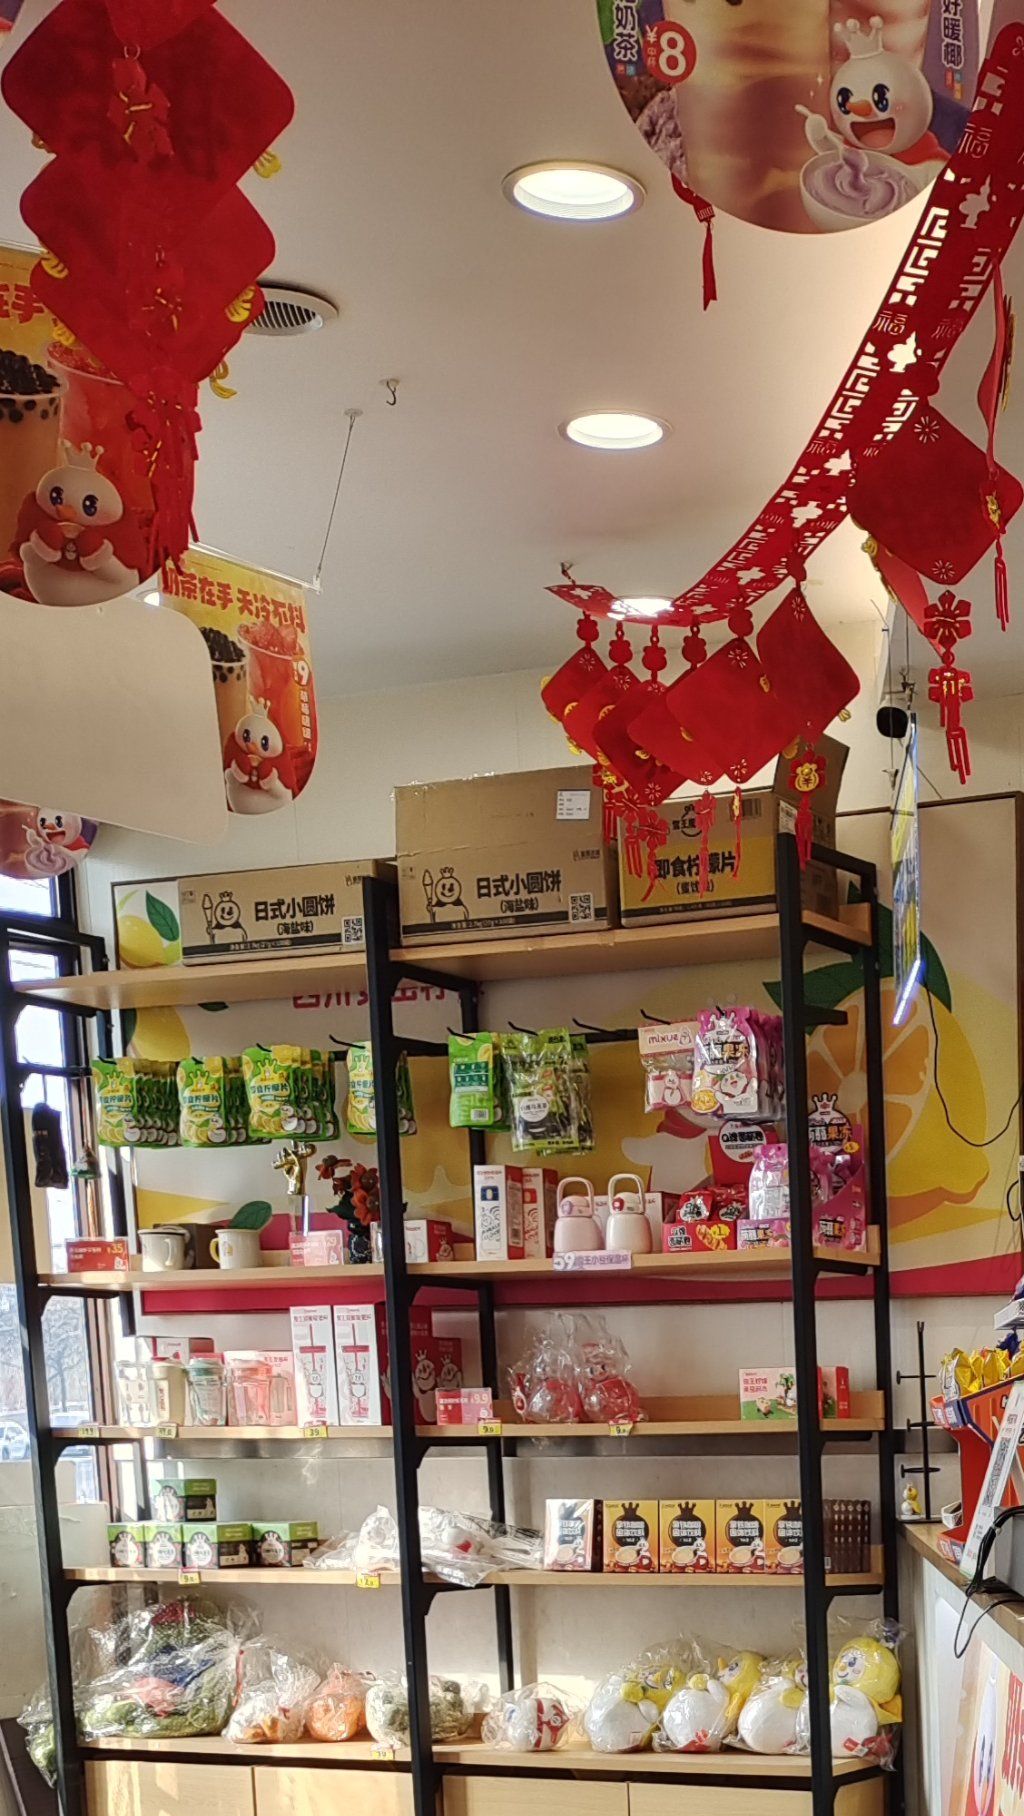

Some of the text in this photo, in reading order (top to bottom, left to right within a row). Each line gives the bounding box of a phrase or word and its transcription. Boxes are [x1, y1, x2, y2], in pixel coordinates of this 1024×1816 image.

[613, 0, 638, 61] 奶茶
[476, 869, 562, 899] 日式小圆饼
[254, 893, 336, 922] 日式小圆饼
